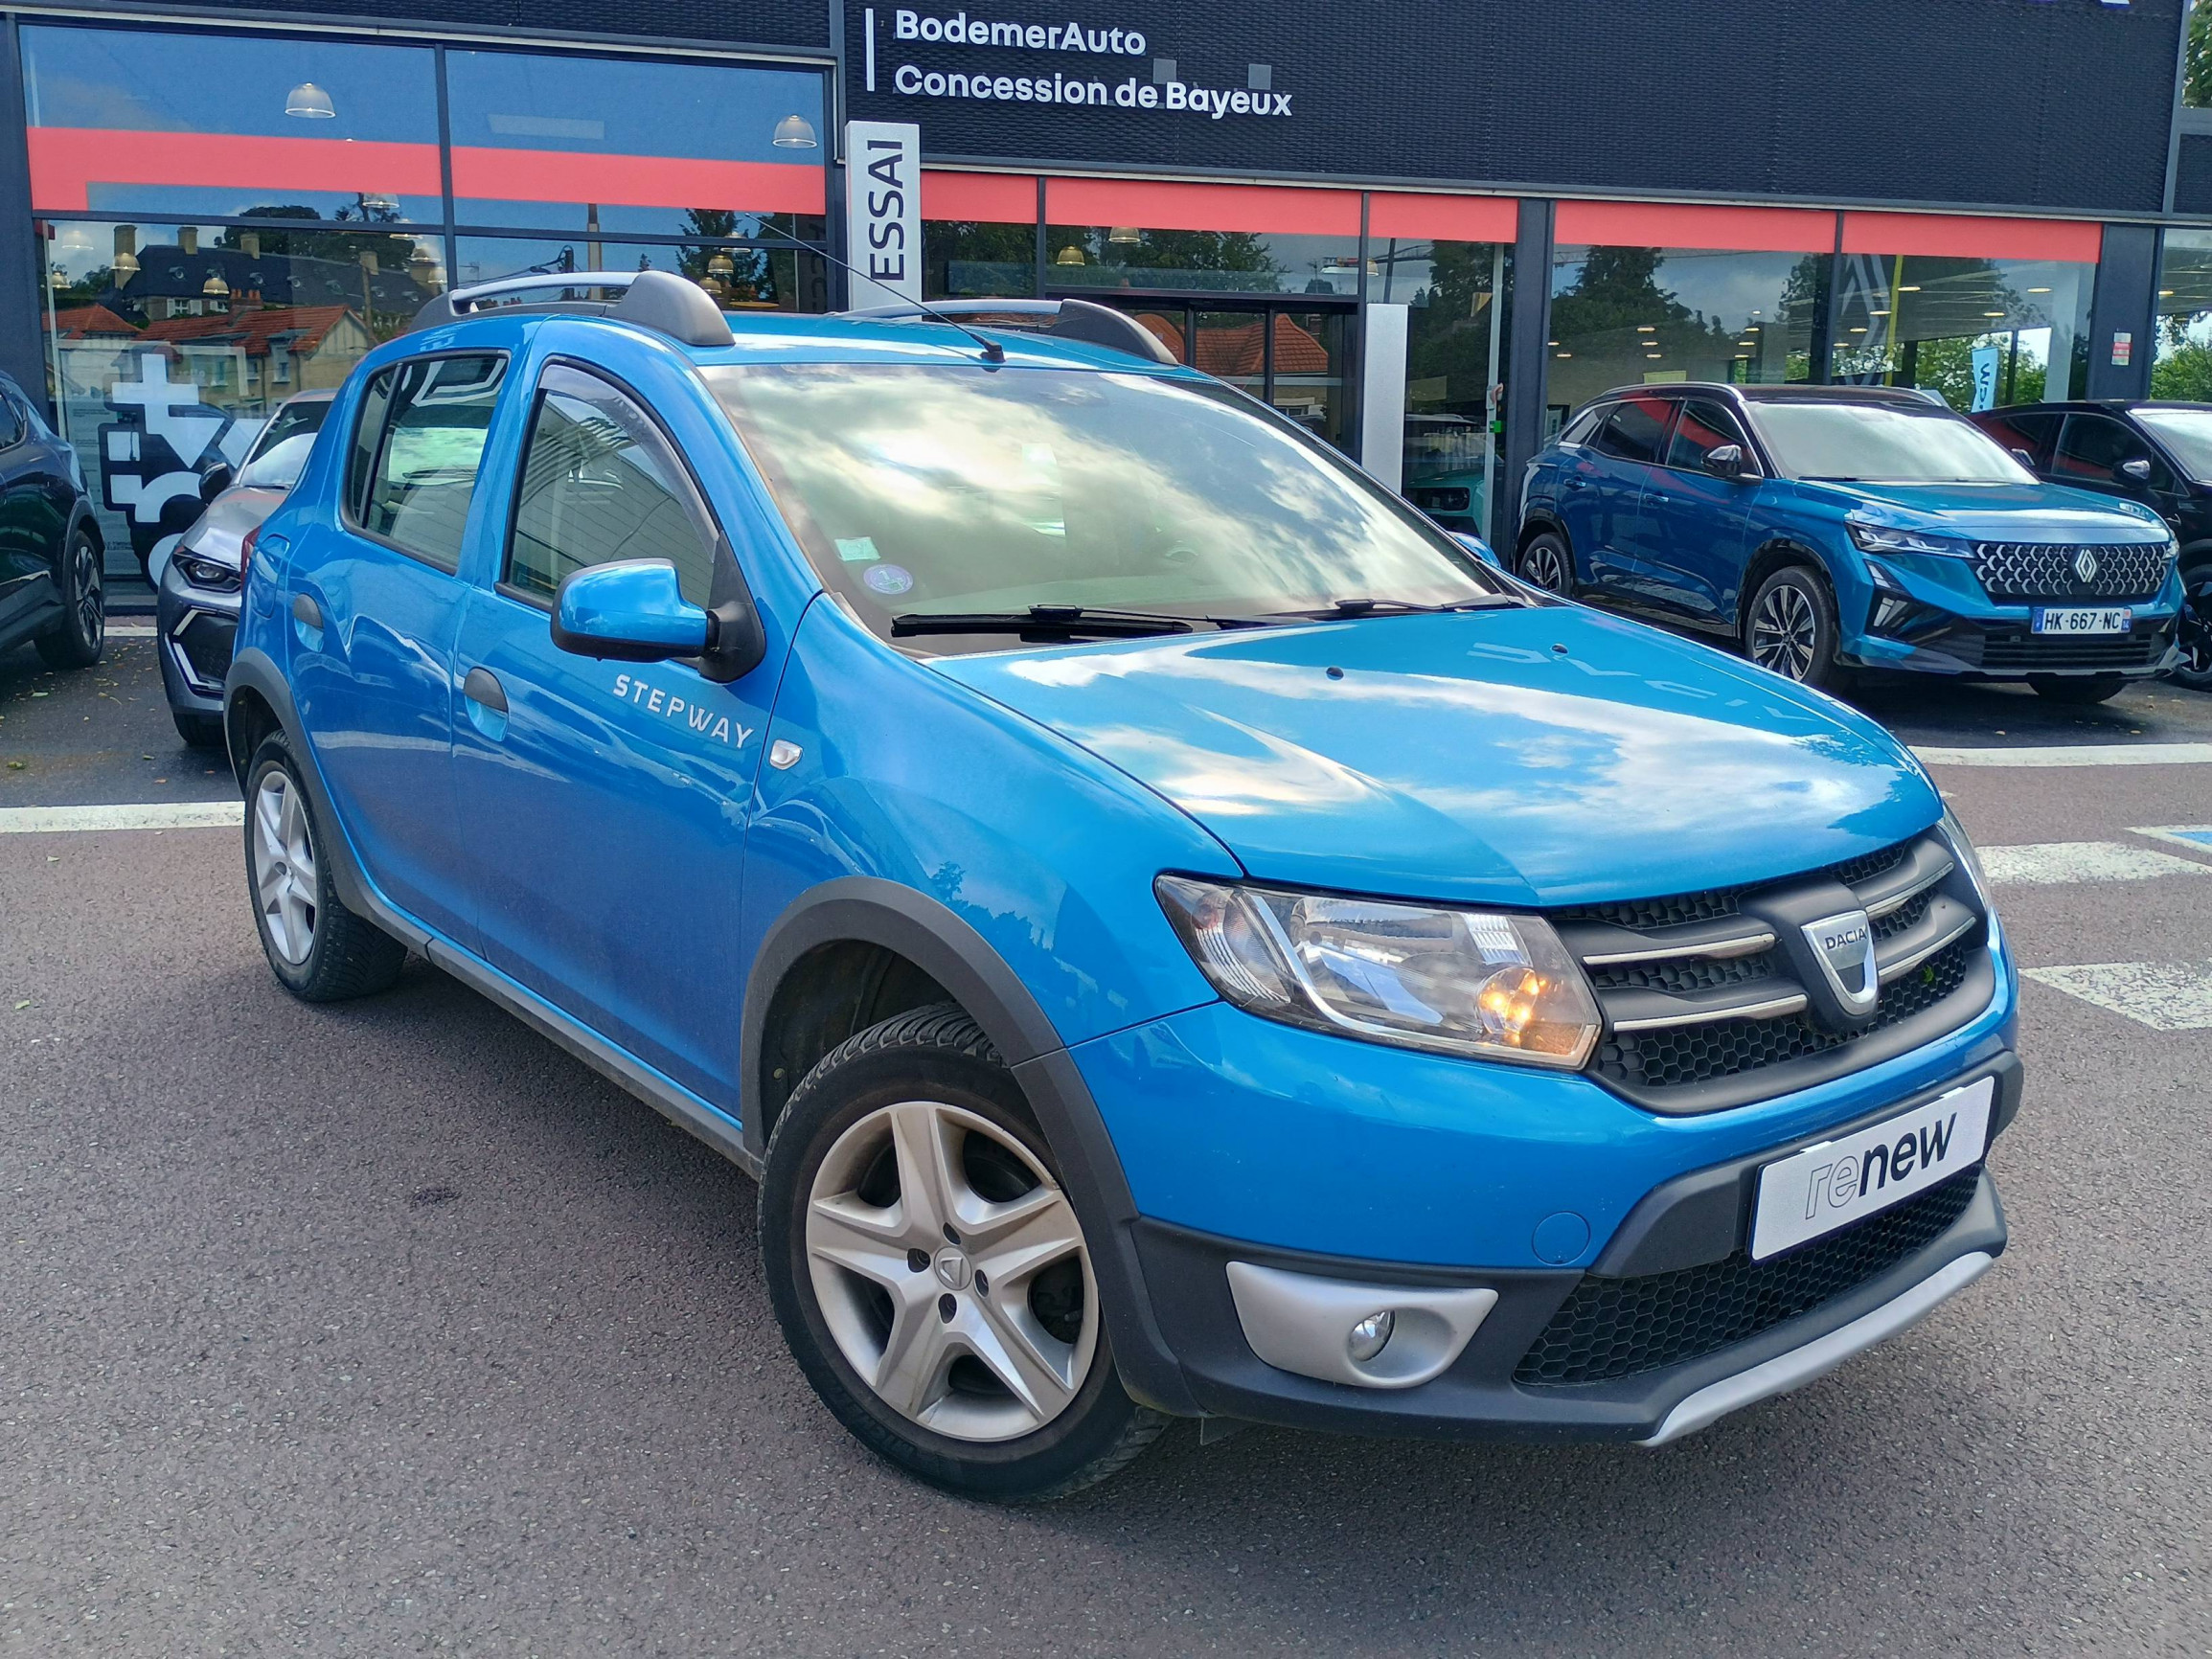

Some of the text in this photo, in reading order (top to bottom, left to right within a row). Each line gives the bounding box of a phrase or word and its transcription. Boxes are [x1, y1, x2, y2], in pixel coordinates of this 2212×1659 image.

[896, 10, 1147, 55] BodemerAuto
[895, 65, 1293, 120] Concession de Bayeux
[867, 140, 904, 281] ESSAI
[2044, 612, 2121, 630] HK-667-NC
[613, 673, 755, 749] STEPWAY
[1825, 928, 1868, 950] DACIA
[1806, 1112, 1957, 1220] renew
